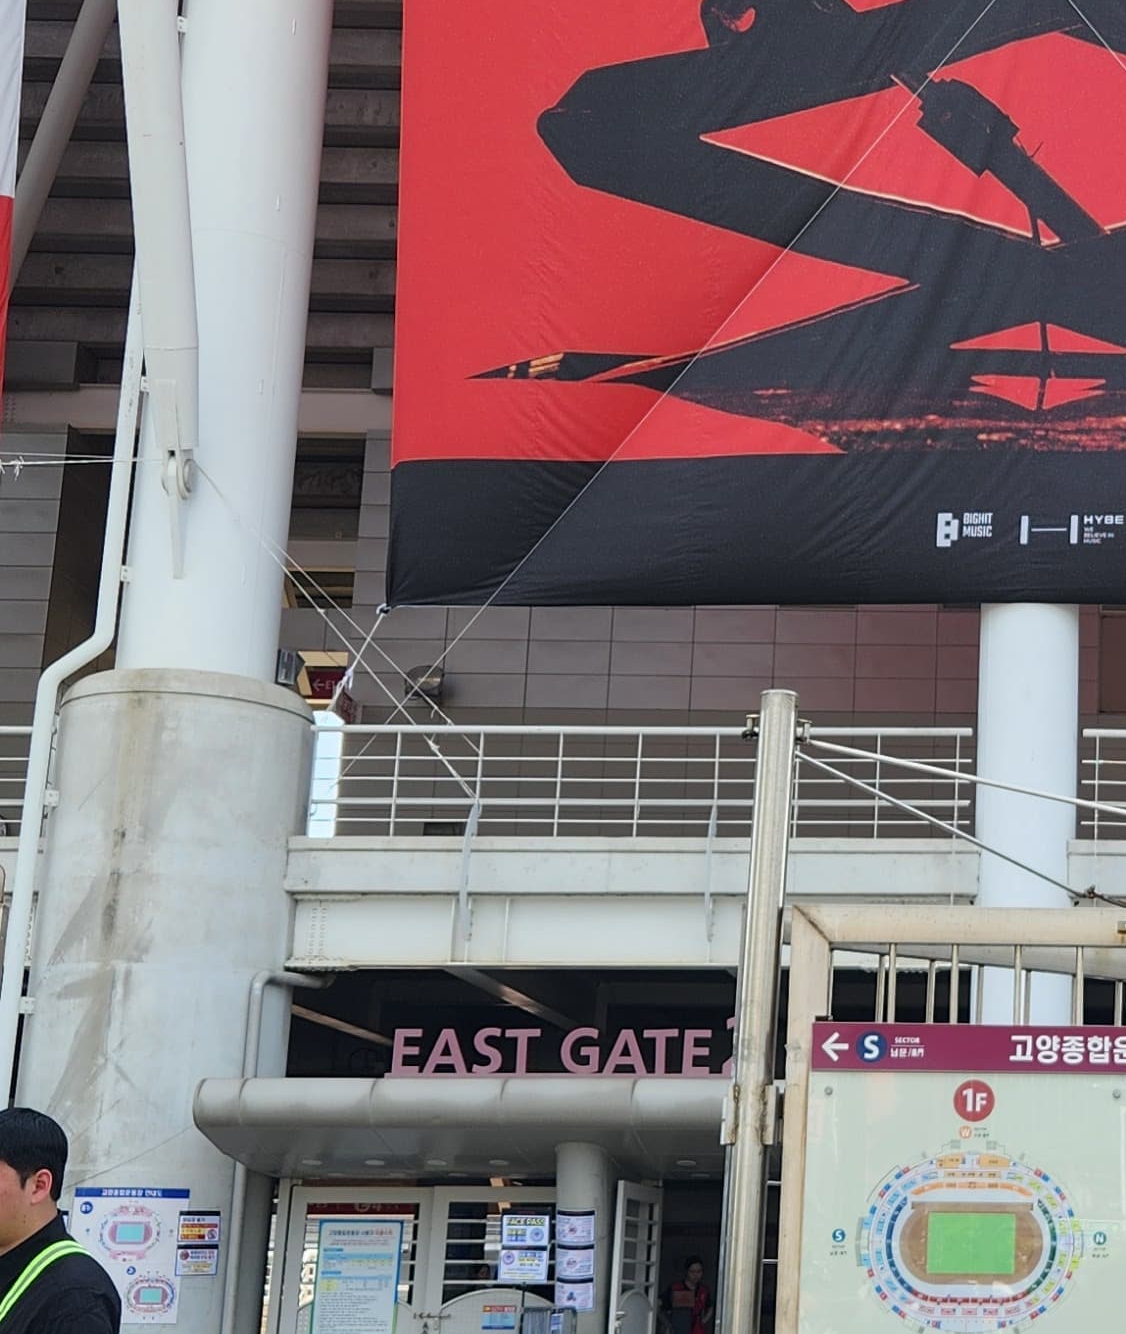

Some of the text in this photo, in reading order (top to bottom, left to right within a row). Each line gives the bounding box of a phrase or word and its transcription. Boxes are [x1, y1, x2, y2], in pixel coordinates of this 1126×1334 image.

[963, 513, 993, 524] BIGHIT
[1083, 515, 1125, 524] HYBE
[962, 525, 993, 537] MUSIC
[391, 1027, 541, 1075] EAST
[559, 1027, 713, 1075] GATE
[863, 1034, 880, 1060] S
[961, 1088, 988, 1112] 1F
